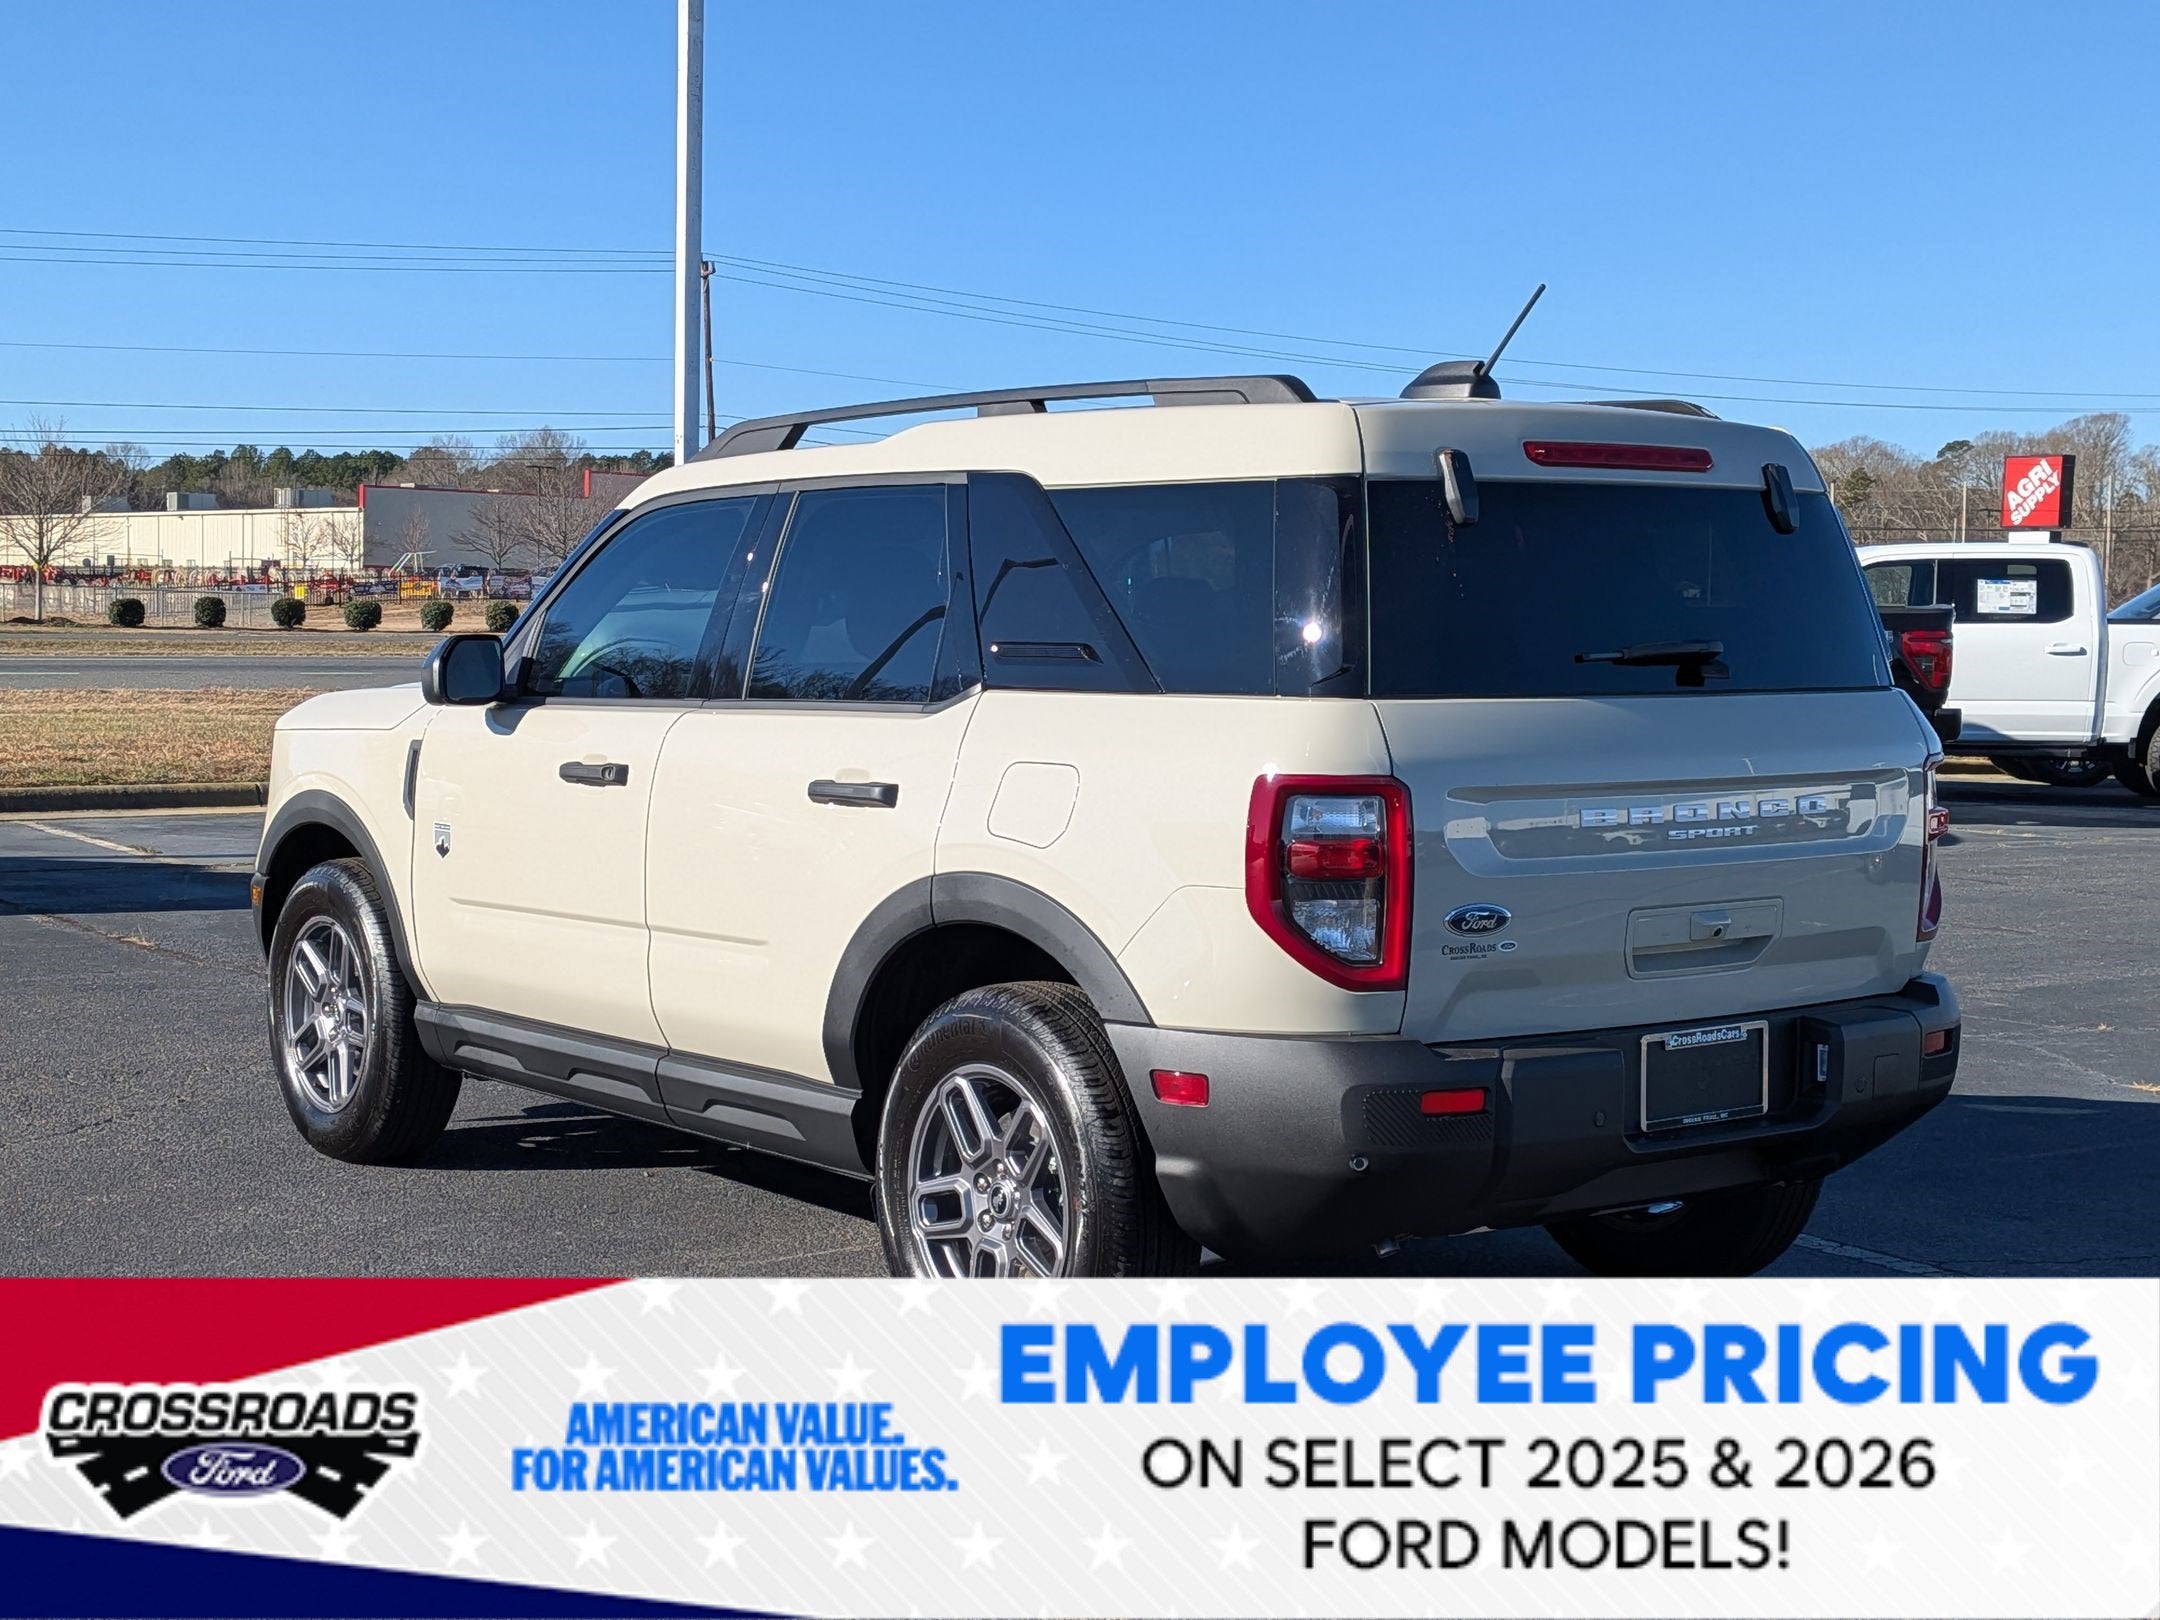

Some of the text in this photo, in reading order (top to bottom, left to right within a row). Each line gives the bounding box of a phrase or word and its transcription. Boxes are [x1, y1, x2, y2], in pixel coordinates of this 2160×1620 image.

[2007, 458, 2053, 511] AGRI
[2010, 470, 2060, 526] SUPPLY
[1579, 796, 1827, 828] BRONCO
[1667, 824, 1758, 841] SPORT
[1461, 911, 1498, 930] Ford
